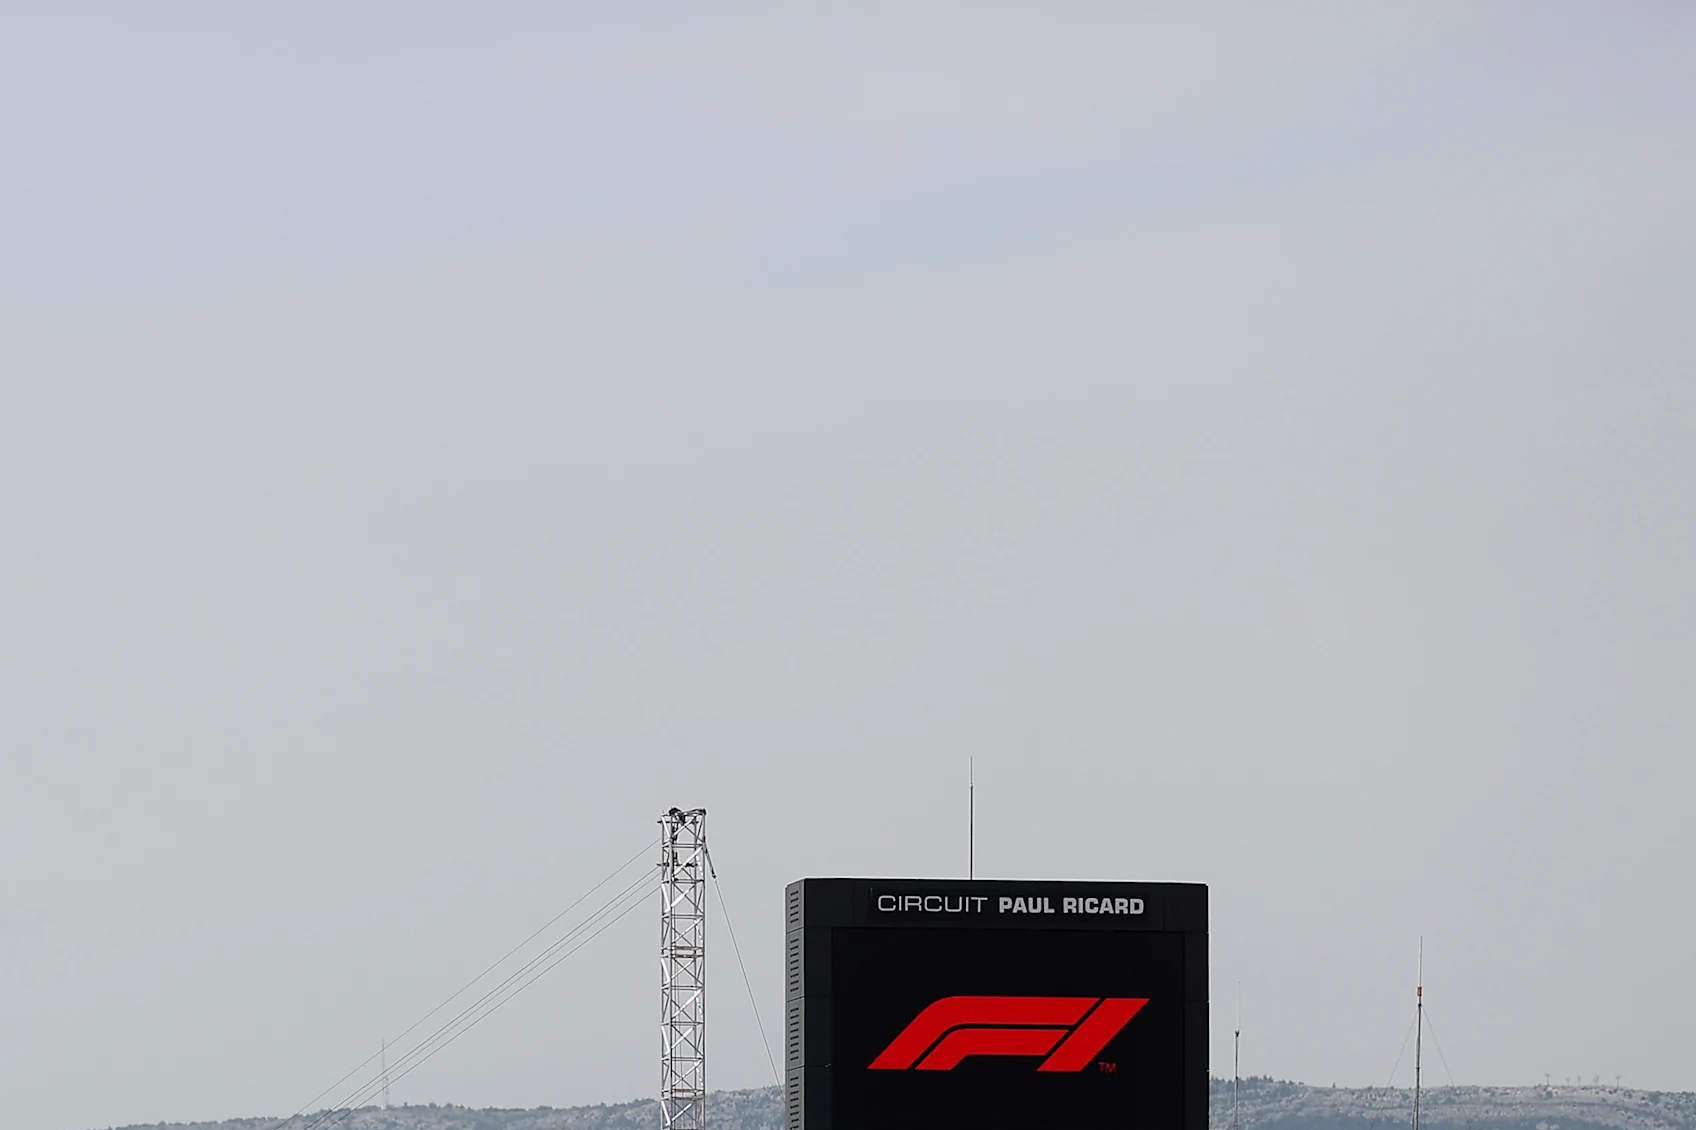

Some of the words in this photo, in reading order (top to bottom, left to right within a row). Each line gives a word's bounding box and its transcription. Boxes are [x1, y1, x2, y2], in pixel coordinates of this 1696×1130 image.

[878, 896, 988, 912] CIRCUIT
[1000, 897, 1054, 913] PAUL
[1064, 898, 1143, 914] RICARD
[869, 996, 1149, 1072] F1
